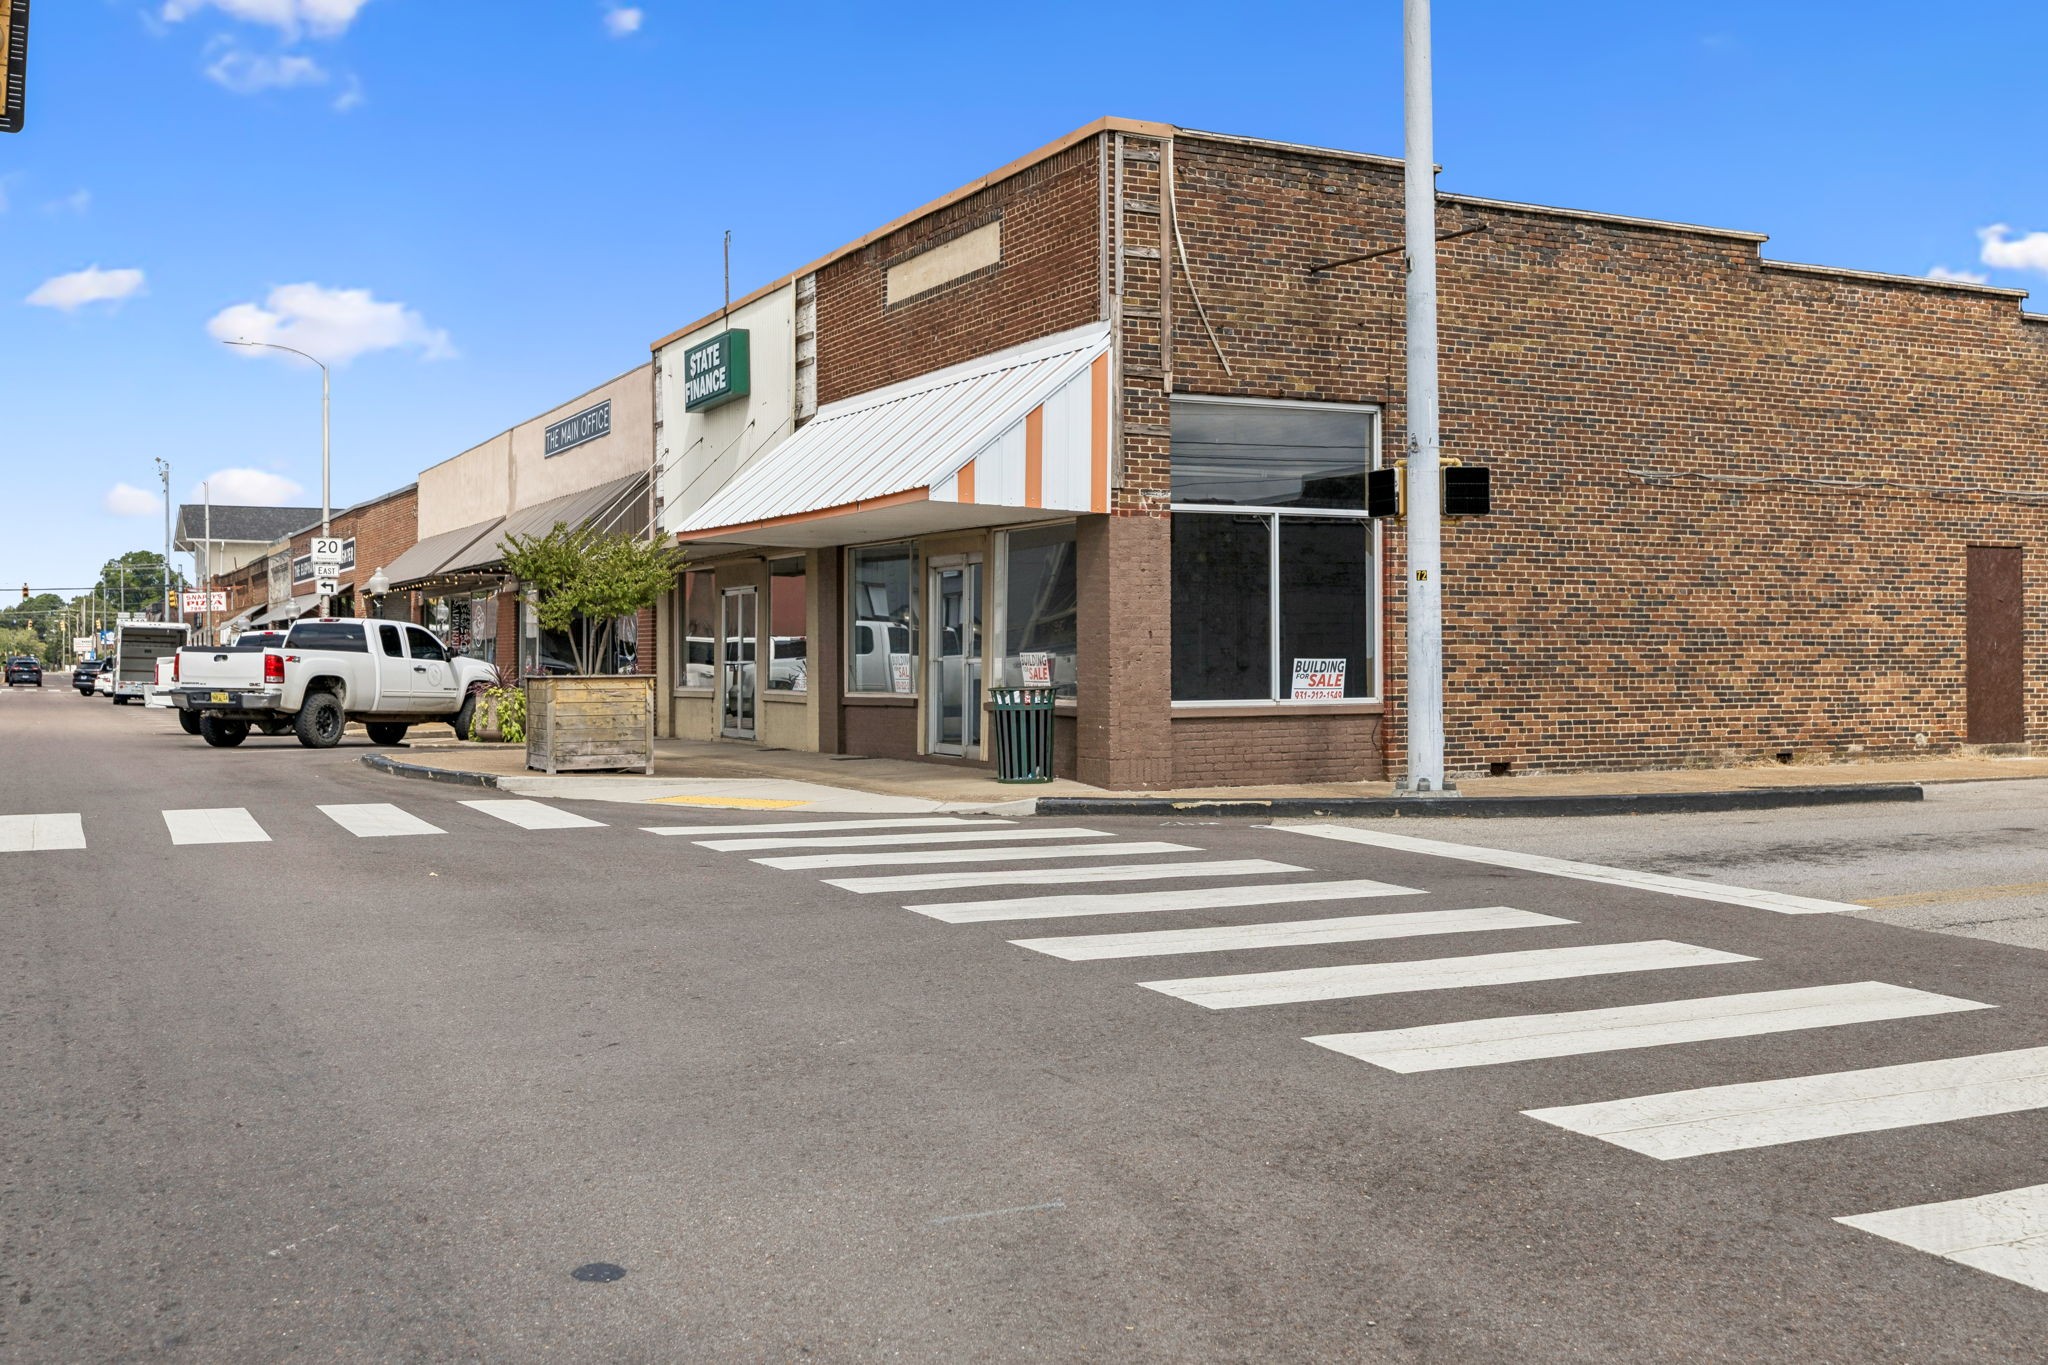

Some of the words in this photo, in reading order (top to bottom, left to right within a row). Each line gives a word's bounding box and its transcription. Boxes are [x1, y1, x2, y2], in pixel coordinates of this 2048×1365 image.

[685, 366, 726, 403] FINANCE
[546, 428, 559, 451] THE
[561, 420, 579, 445] MAIN
[581, 407, 609, 437] OFFICE
[317, 540, 338, 554] 20
[318, 567, 335, 575] EAST
[1020, 654, 1047, 666] BUILDING
[1029, 667, 1048, 680] SALE
[1295, 661, 1345, 673] BUILDING
[1308, 674, 1343, 687] SALE
